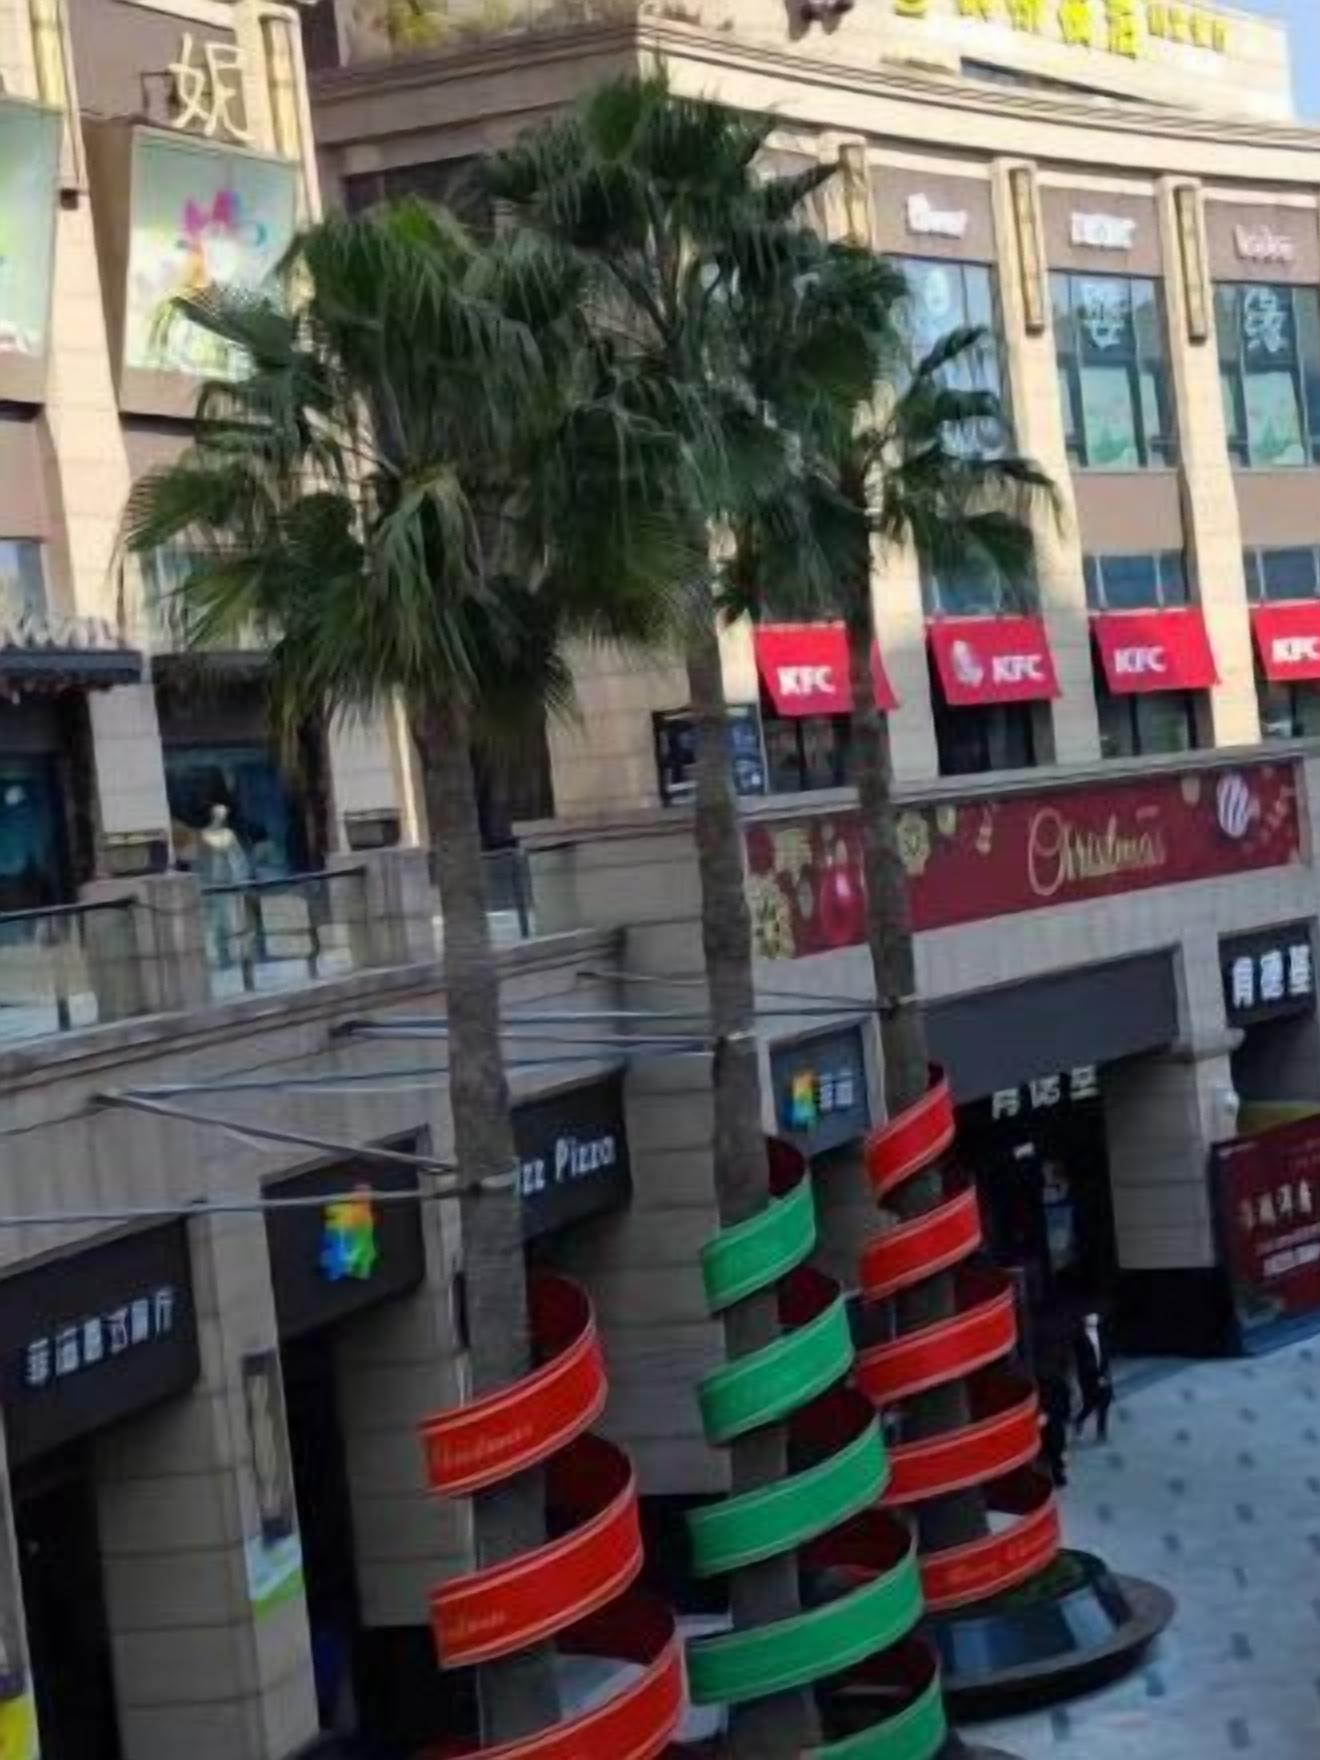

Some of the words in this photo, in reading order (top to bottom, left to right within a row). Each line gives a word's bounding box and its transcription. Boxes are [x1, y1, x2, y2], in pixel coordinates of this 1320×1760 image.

[167, 32, 256, 141] 妮
[991, 654, 1045, 683] KFC
[1114, 646, 1166, 674] KFC
[778, 664, 836, 696] KFC
[555, 1133, 617, 1182] Pizza
